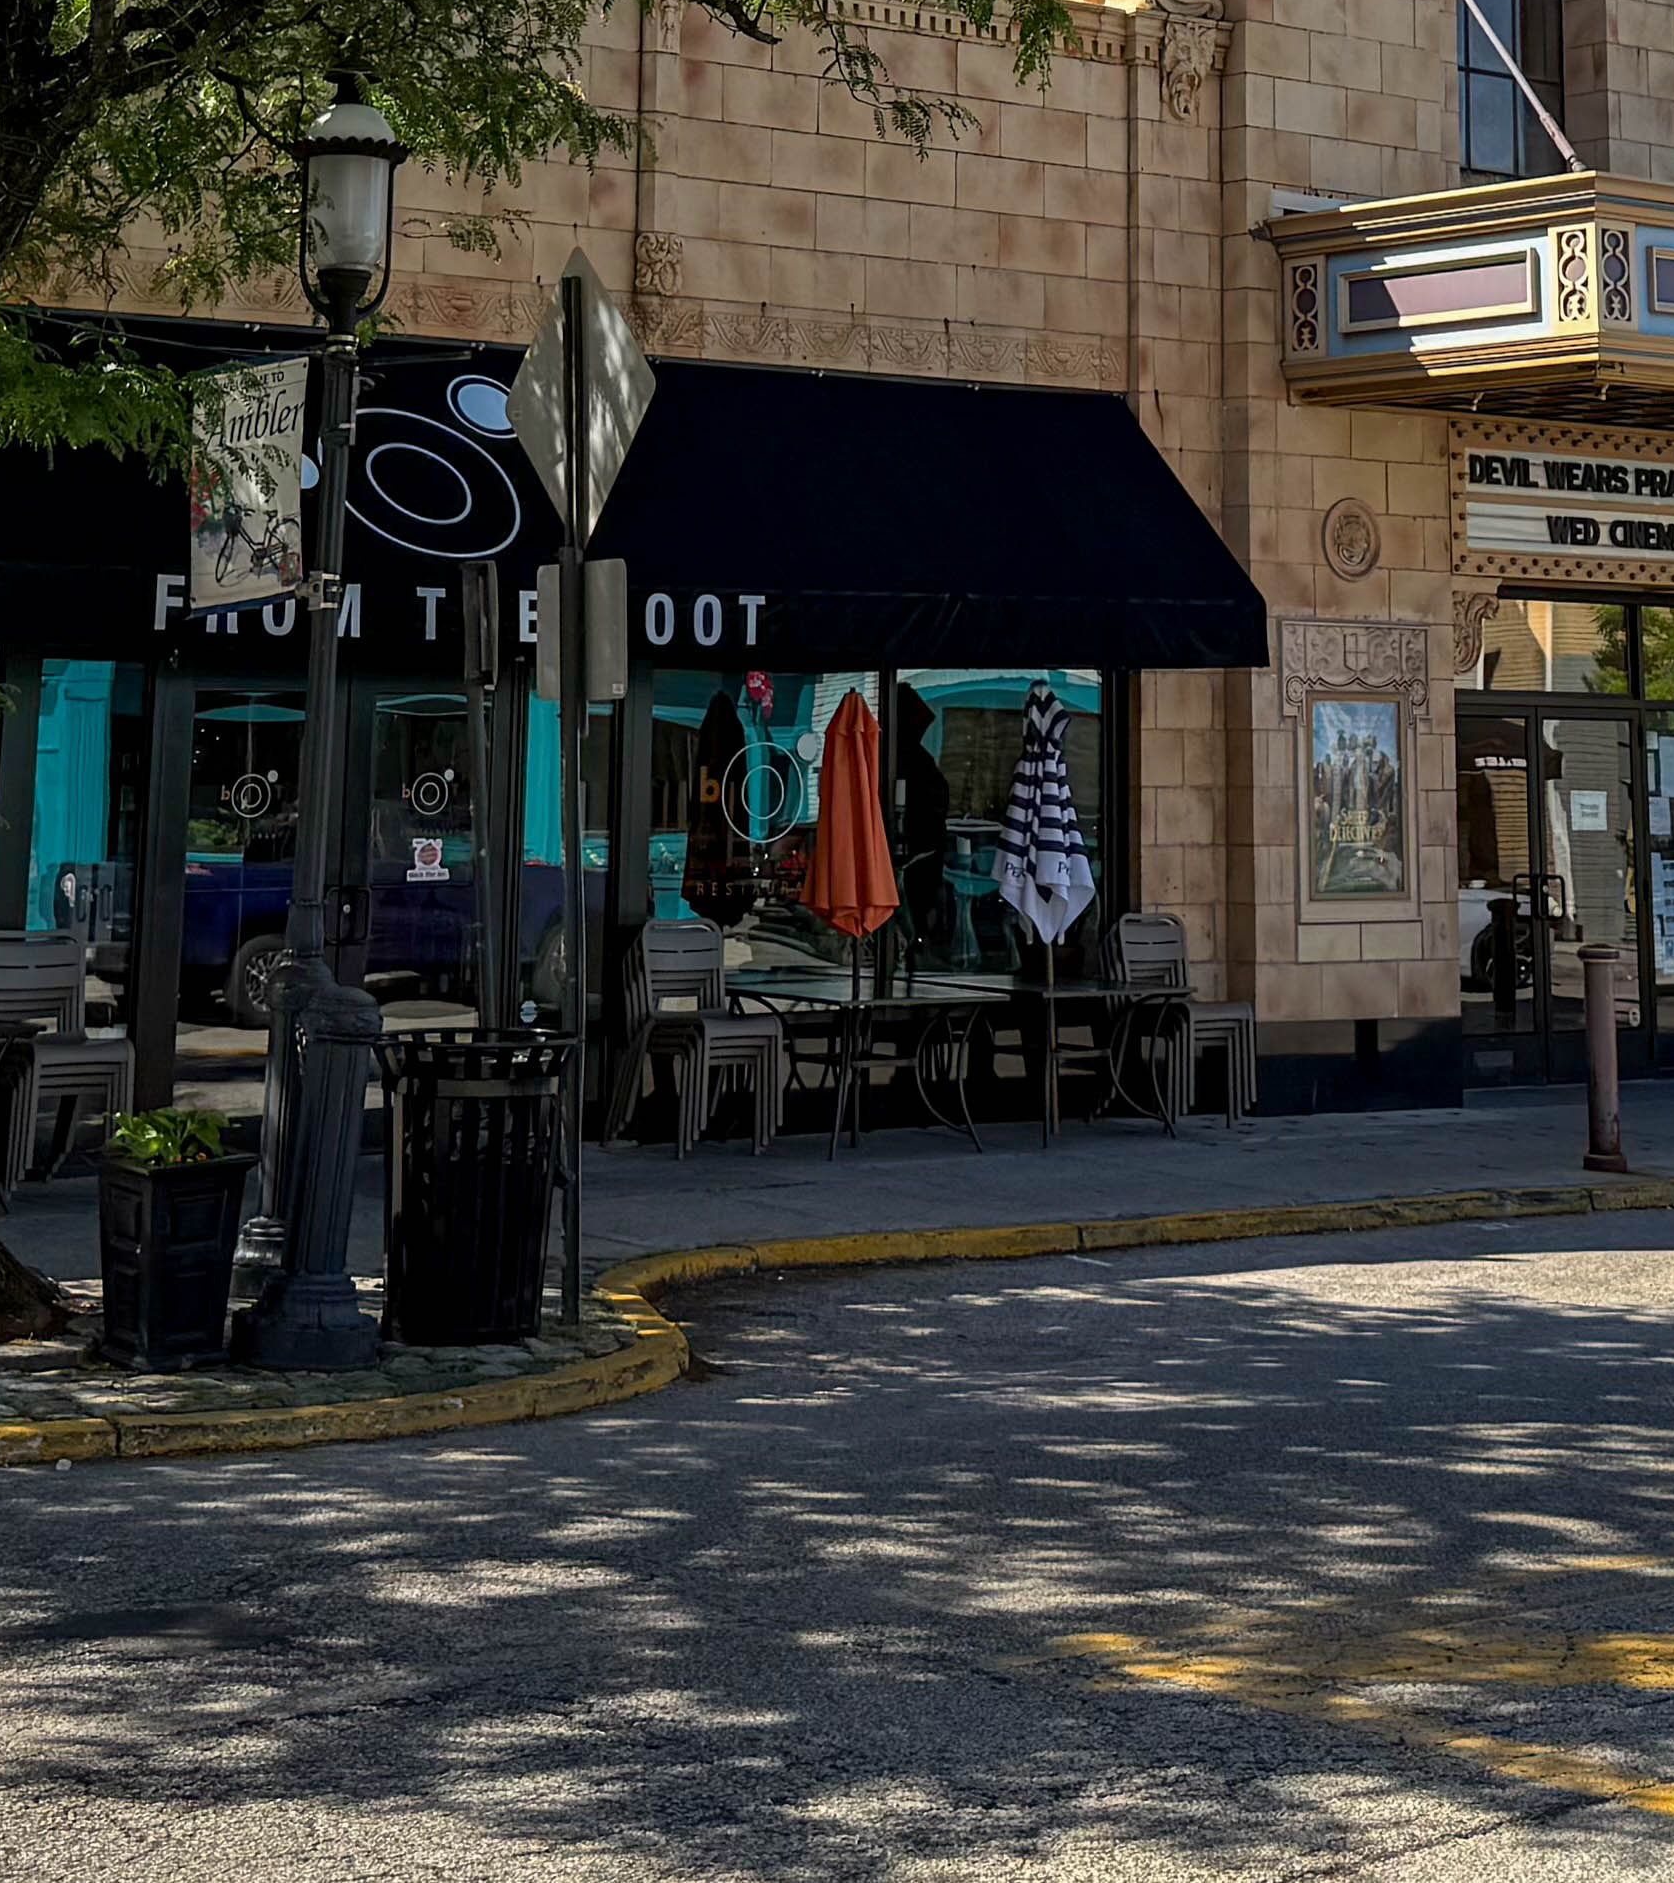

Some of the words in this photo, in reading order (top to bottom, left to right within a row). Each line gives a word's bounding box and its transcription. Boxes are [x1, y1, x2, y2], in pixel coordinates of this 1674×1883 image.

[272, 371, 284, 383] TO
[1468, 453, 1539, 488] DEVIL
[1543, 459, 1629, 494] WEARS
[1546, 515, 1600, 546] WED
[416, 586, 538, 642] TE
[645, 593, 766, 646] OOT
